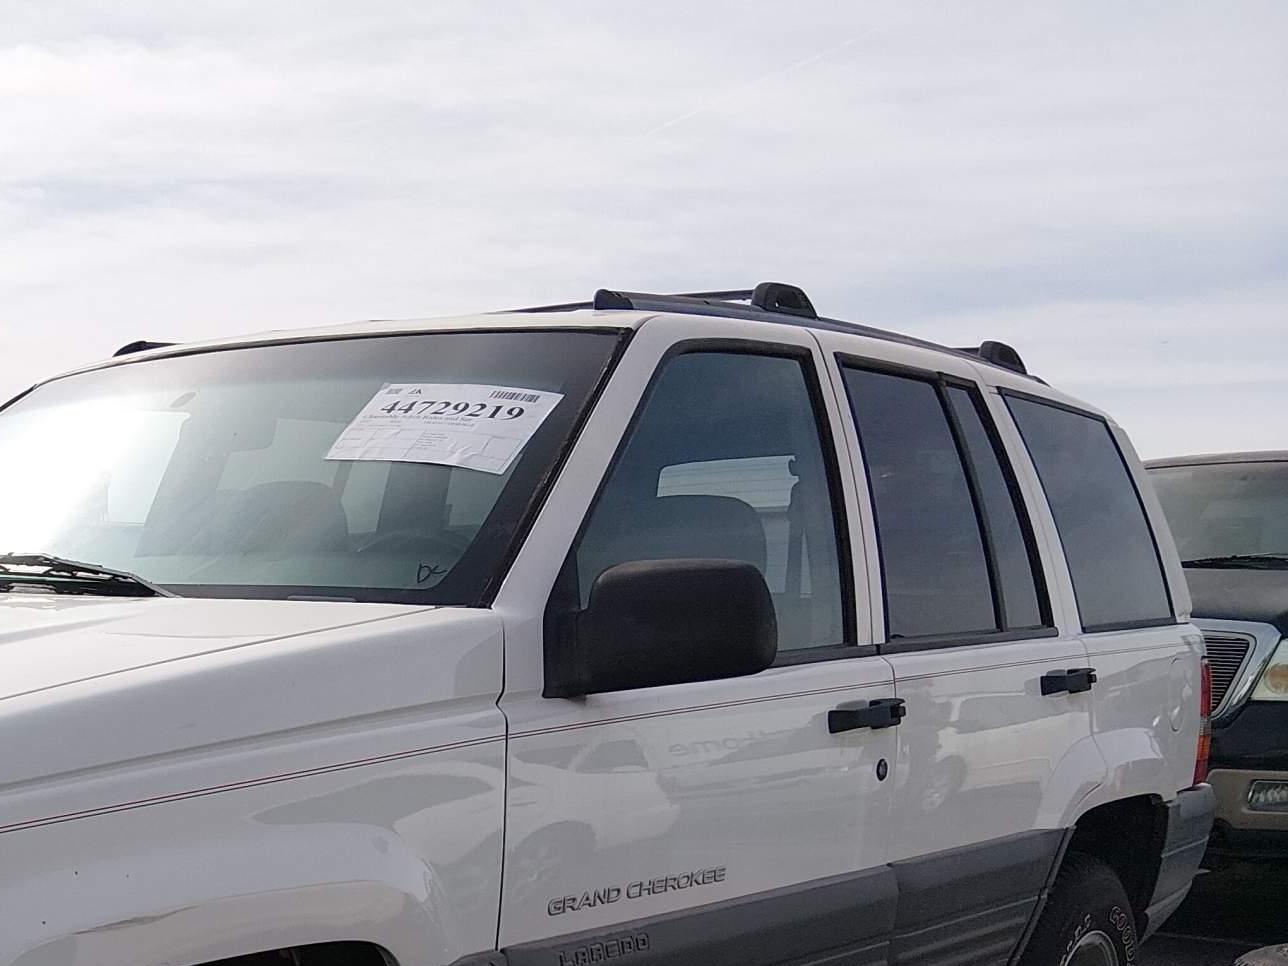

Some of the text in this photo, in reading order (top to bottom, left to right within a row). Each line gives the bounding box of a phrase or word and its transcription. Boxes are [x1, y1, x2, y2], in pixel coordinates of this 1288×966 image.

[380, 400, 525, 421] 44729219
[547, 867, 726, 916] GRAND CHEROKEE
